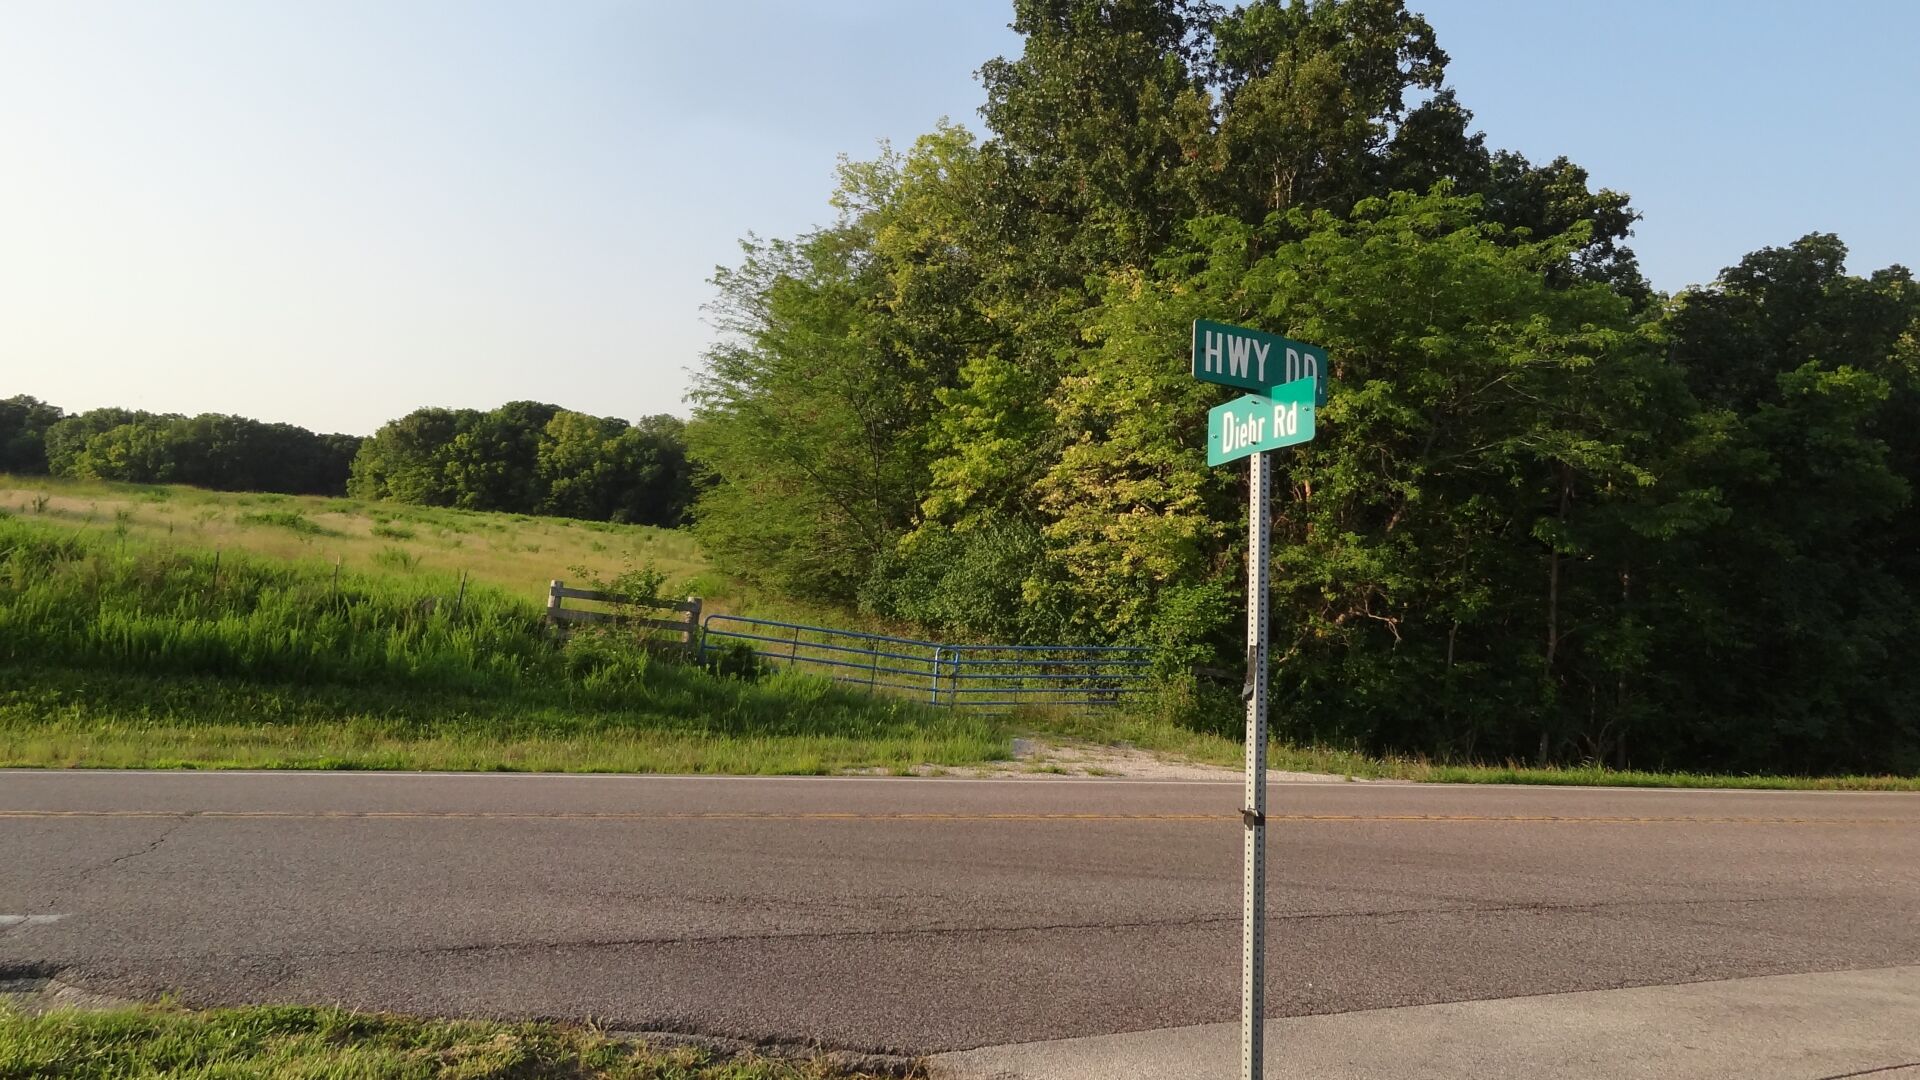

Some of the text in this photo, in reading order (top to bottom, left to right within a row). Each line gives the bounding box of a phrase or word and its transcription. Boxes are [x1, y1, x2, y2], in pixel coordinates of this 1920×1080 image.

[1205, 330, 1271, 382] HWY
[1222, 401, 1298, 454] Diehr Rd
